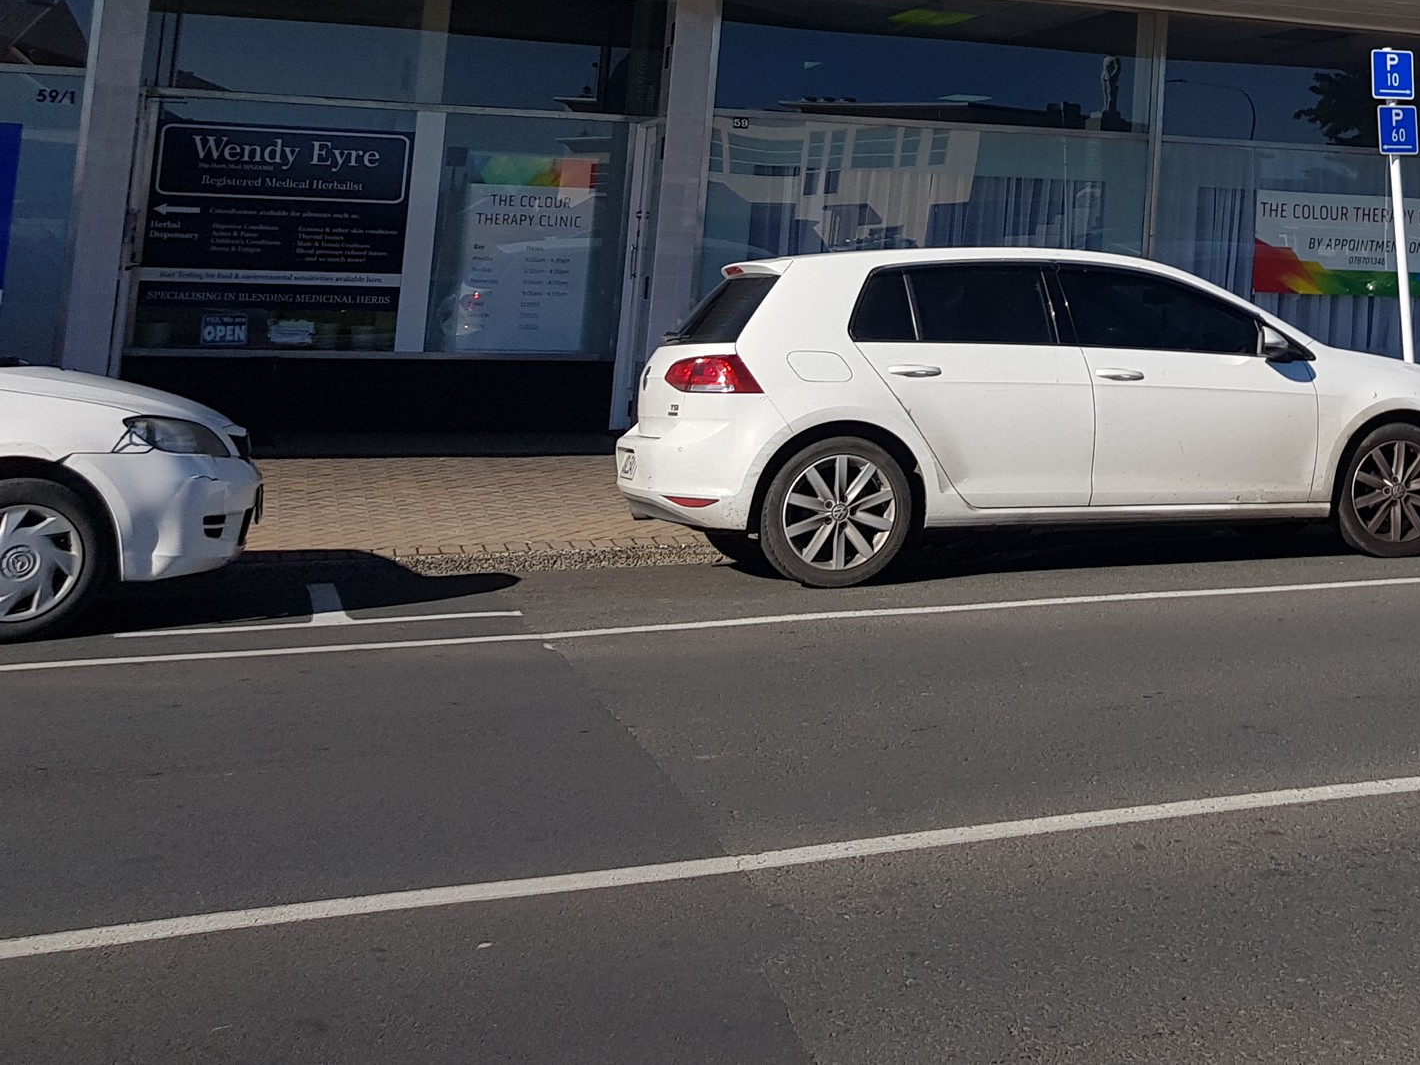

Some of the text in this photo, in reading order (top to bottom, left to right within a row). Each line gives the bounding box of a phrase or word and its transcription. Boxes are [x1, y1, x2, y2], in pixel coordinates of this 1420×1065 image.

[1386, 53, 1399, 72] P
[1387, 73, 1399, 87] 10
[733, 118, 749, 128] 59
[1391, 109, 1404, 127] P
[1391, 128, 1406, 142] 60
[193, 134, 381, 172] Wendy Eyre
[201, 174, 364, 192] Registered Medical Herbalist
[491, 194, 572, 209] THE COLOUR
[476, 212, 582, 229] THERAPY CLINIC
[1260, 202, 1287, 219] THE
[1293, 204, 1349, 222] COLOUR
[1353, 206, 1414, 224] THERY
[150, 220, 181, 230] Herbal
[149, 230, 199, 241] Dispensary
[1308, 237, 1323, 250] BY
[1325, 237, 1398, 254] APPOINTMEN
[146, 290, 391, 305] SPECIALISING IN BLENDING MEDICINAL HERBS
[203, 325, 247, 342] OPEN
